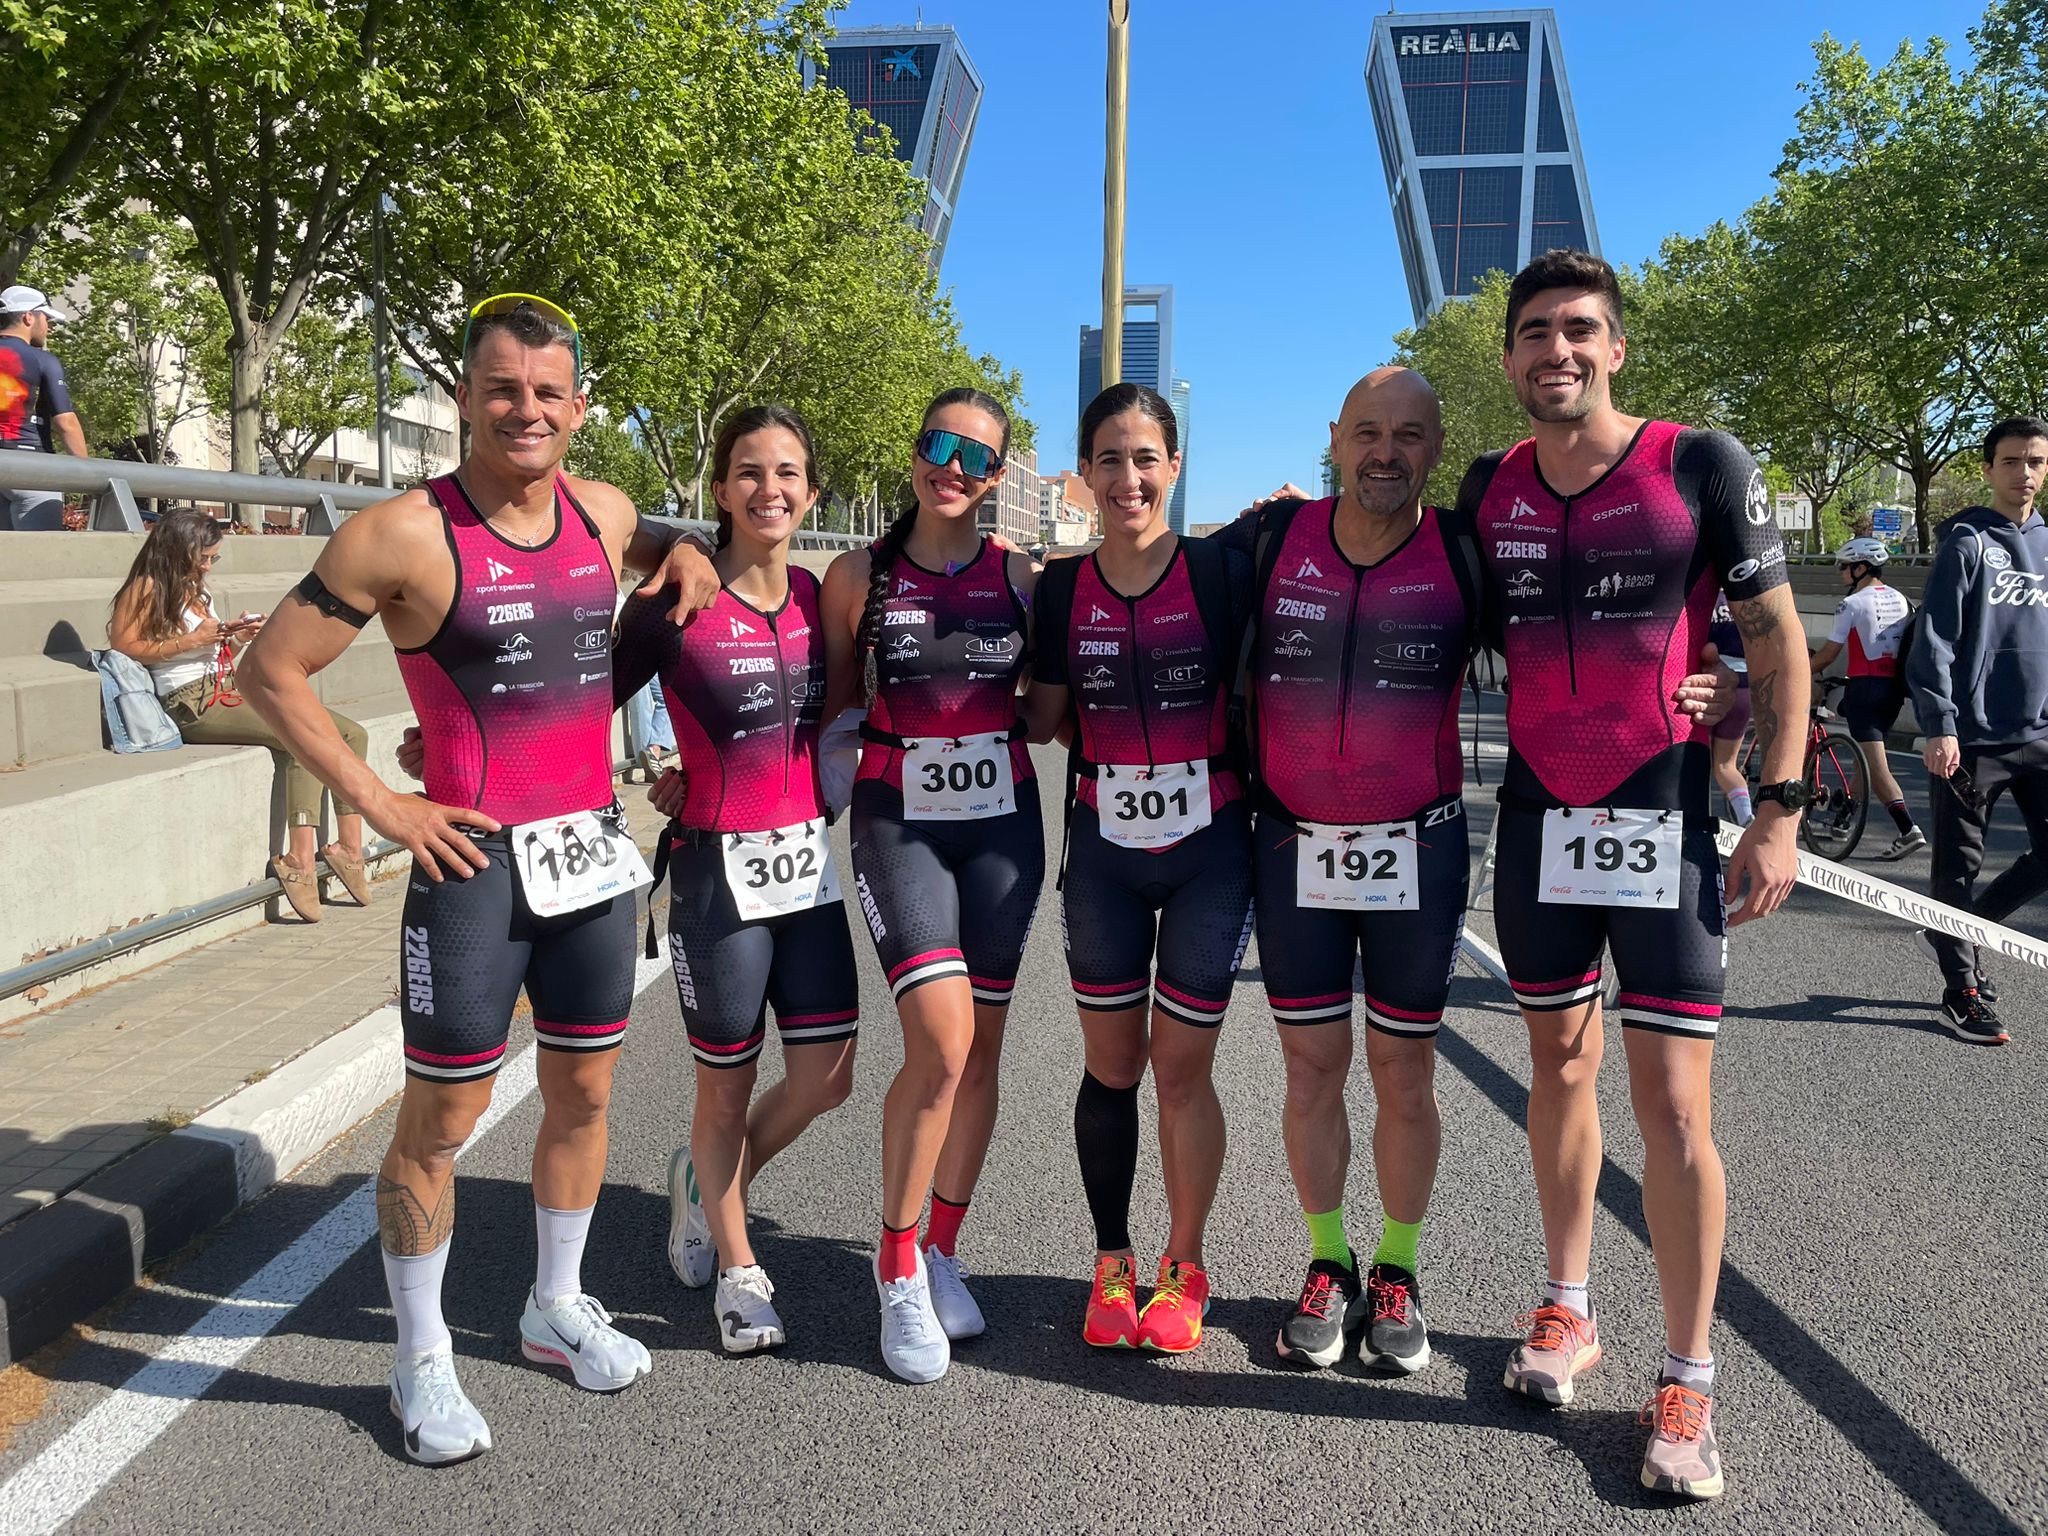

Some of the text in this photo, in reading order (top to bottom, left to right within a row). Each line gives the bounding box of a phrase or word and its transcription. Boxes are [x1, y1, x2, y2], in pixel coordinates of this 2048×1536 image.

[1592, 503, 1640, 522] GSPORT
[1513, 523, 1557, 534] xperience
[1496, 541, 1547, 559] 226ERS
[569, 564, 600, 578] GSPORT
[1625, 573, 1656, 582] SANDS
[499, 582, 535, 592] xperience
[1297, 582, 1341, 597] xperience
[1389, 583, 1436, 594] GSPORT
[1624, 580, 1654, 588] BEACH
[968, 591, 999, 599] GSPORT
[1507, 586, 1543, 599] sailfish
[487, 602, 534, 625] 226ERS
[1275, 597, 1327, 621] 226ERS
[884, 610, 927, 626] 226ERS
[1153, 612, 1189, 624] GSPORT
[585, 632, 602, 647] ICT
[980, 639, 1002, 652] ICT
[886, 648, 920, 661] sailfish
[1078, 640, 1119, 656] 226ERS
[1274, 645, 1312, 658] sailfish
[1397, 644, 1430, 660] ICT
[495, 649, 532, 664] sailfish
[729, 657, 776, 675] 226ERS
[1168, 666, 1193, 681] ICT
[1082, 679, 1115, 691] sailfish
[738, 697, 774, 713] sailfish
[921, 758, 997, 793] 300
[969, 803, 989, 812] HOKA
[1114, 787, 1188, 821] 301
[1163, 831, 1184, 839] HOKA
[538, 836, 617, 882] 180
[1564, 836, 1658, 874] 193
[744, 847, 818, 889] 302
[1316, 848, 1398, 881] 192
[597, 880, 620, 893] HOKA
[1616, 889, 1642, 898] HOKA
[1811, 864, 1888, 909] SPECIALIZED
[794, 892, 813, 903] HOKA
[856, 872, 887, 944] 226ERS
[405, 925, 434, 1016] 226ERS
[669, 932, 698, 1011] 226ERS
